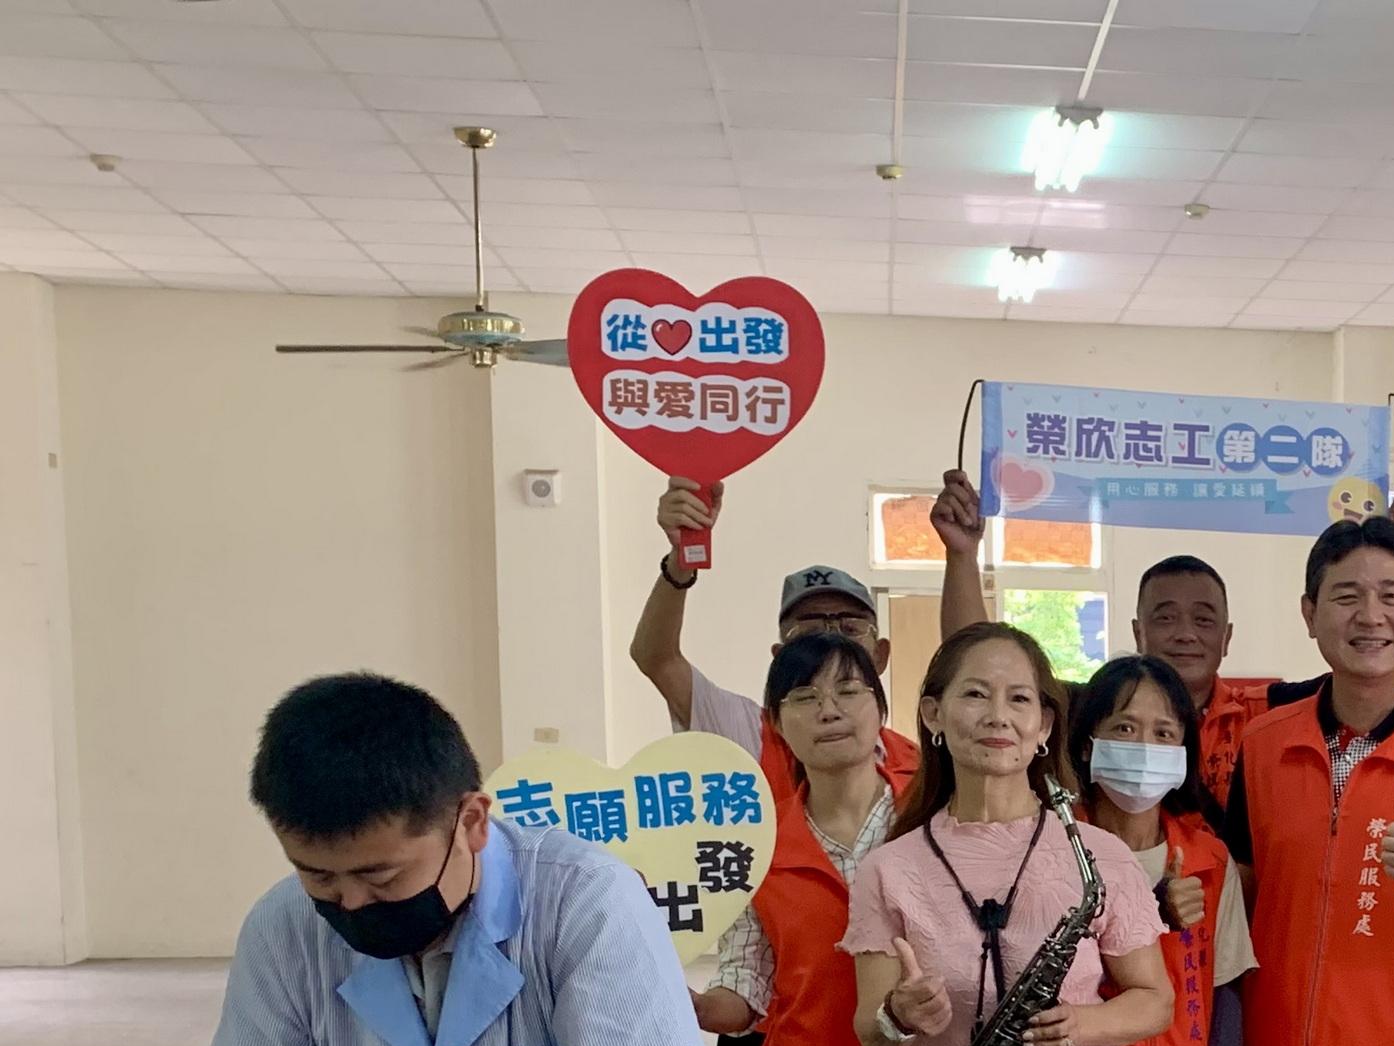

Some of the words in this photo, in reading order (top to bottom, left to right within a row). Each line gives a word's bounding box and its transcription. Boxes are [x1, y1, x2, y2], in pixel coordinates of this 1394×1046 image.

[607, 377, 785, 424] 與愛同行
[1025, 412, 1348, 470] 榮欣志工第二隊
[496, 771, 763, 844] 志願服務
[1352, 817, 1388, 938] 榮民服務處
